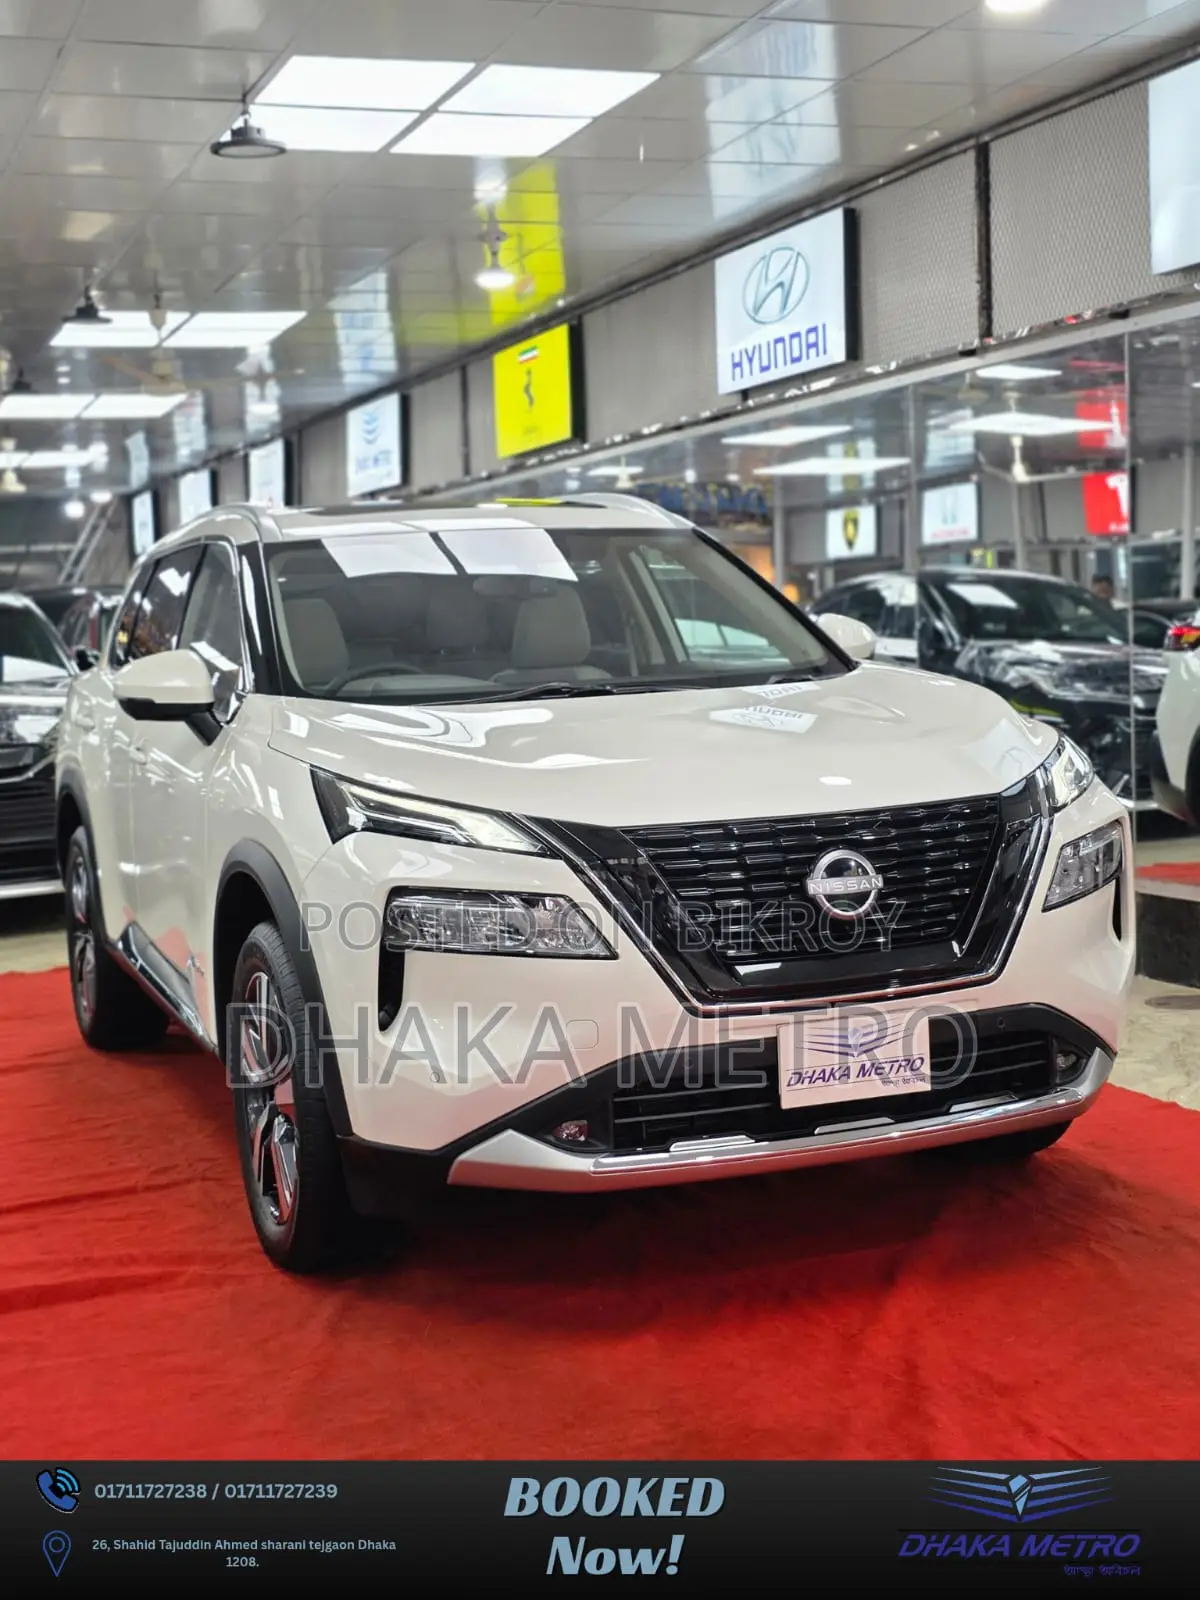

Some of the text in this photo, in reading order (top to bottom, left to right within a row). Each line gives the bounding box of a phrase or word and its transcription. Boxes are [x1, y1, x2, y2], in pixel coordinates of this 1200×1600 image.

[730, 323, 828, 382] HYUNDAI
[809, 877, 883, 893] NISSAN
[786, 1056, 925, 1088] DHAKA METRO
